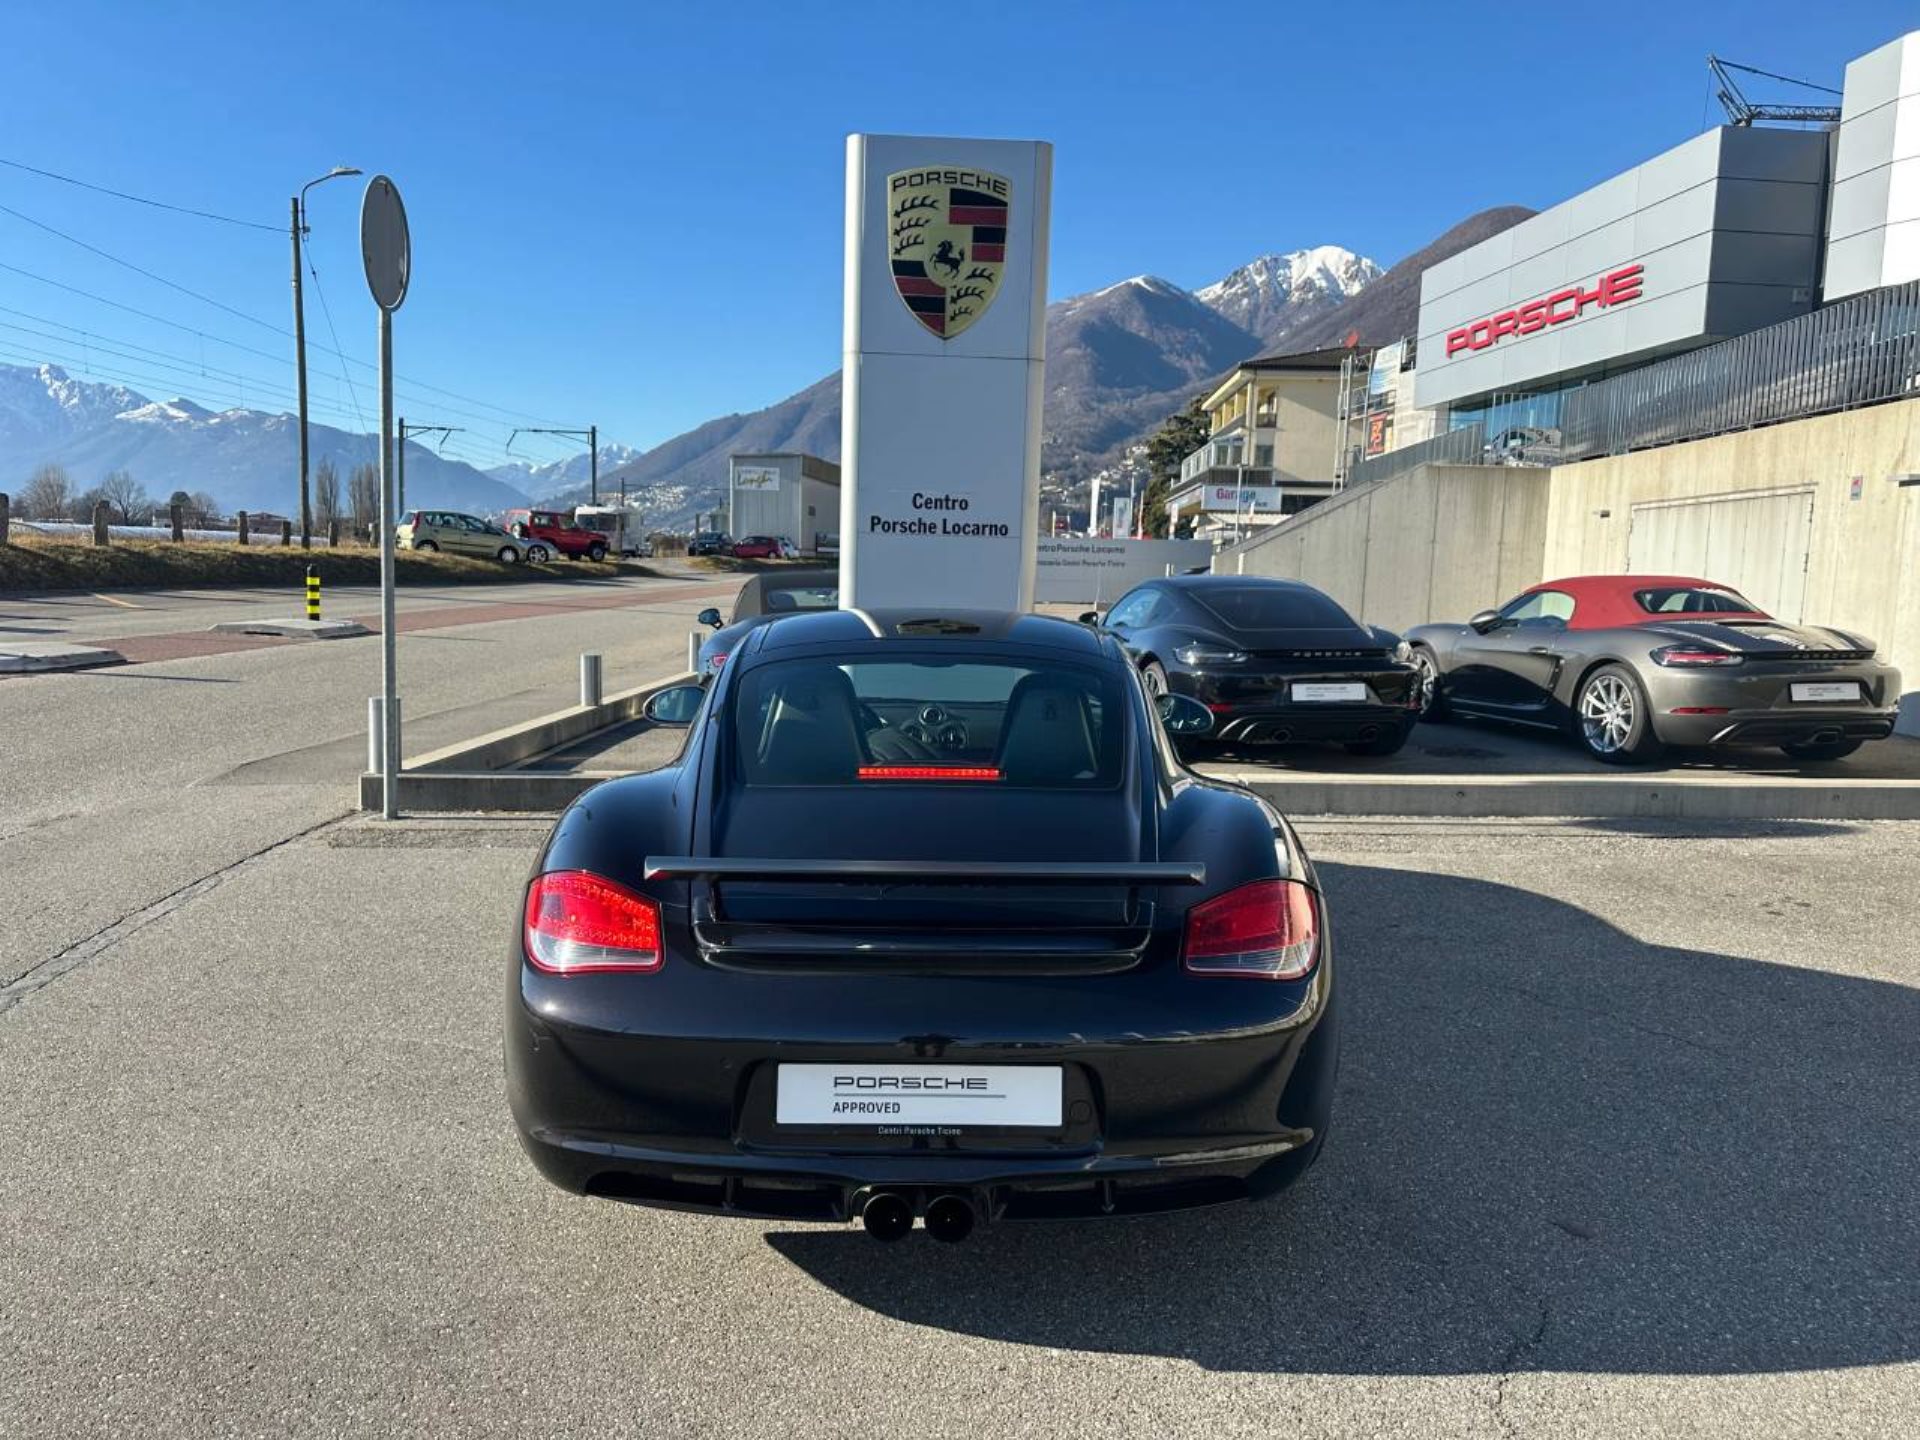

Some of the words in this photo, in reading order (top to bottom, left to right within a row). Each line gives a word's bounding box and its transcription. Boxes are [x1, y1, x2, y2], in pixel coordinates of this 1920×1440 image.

[893, 171, 1007, 196] PORSCHE
[1446, 264, 1644, 359] PORSCHE
[911, 492, 968, 511] Centro
[870, 515, 936, 535] Porsche
[942, 517, 1008, 536] Locarno
[1057, 544, 1091, 553] Porsche
[833, 1076, 988, 1090] PORSCHE
[833, 1102, 901, 1114] APPROVED
[904, 1126, 935, 1135] Porsche
[938, 1127, 962, 1135] Ticino
